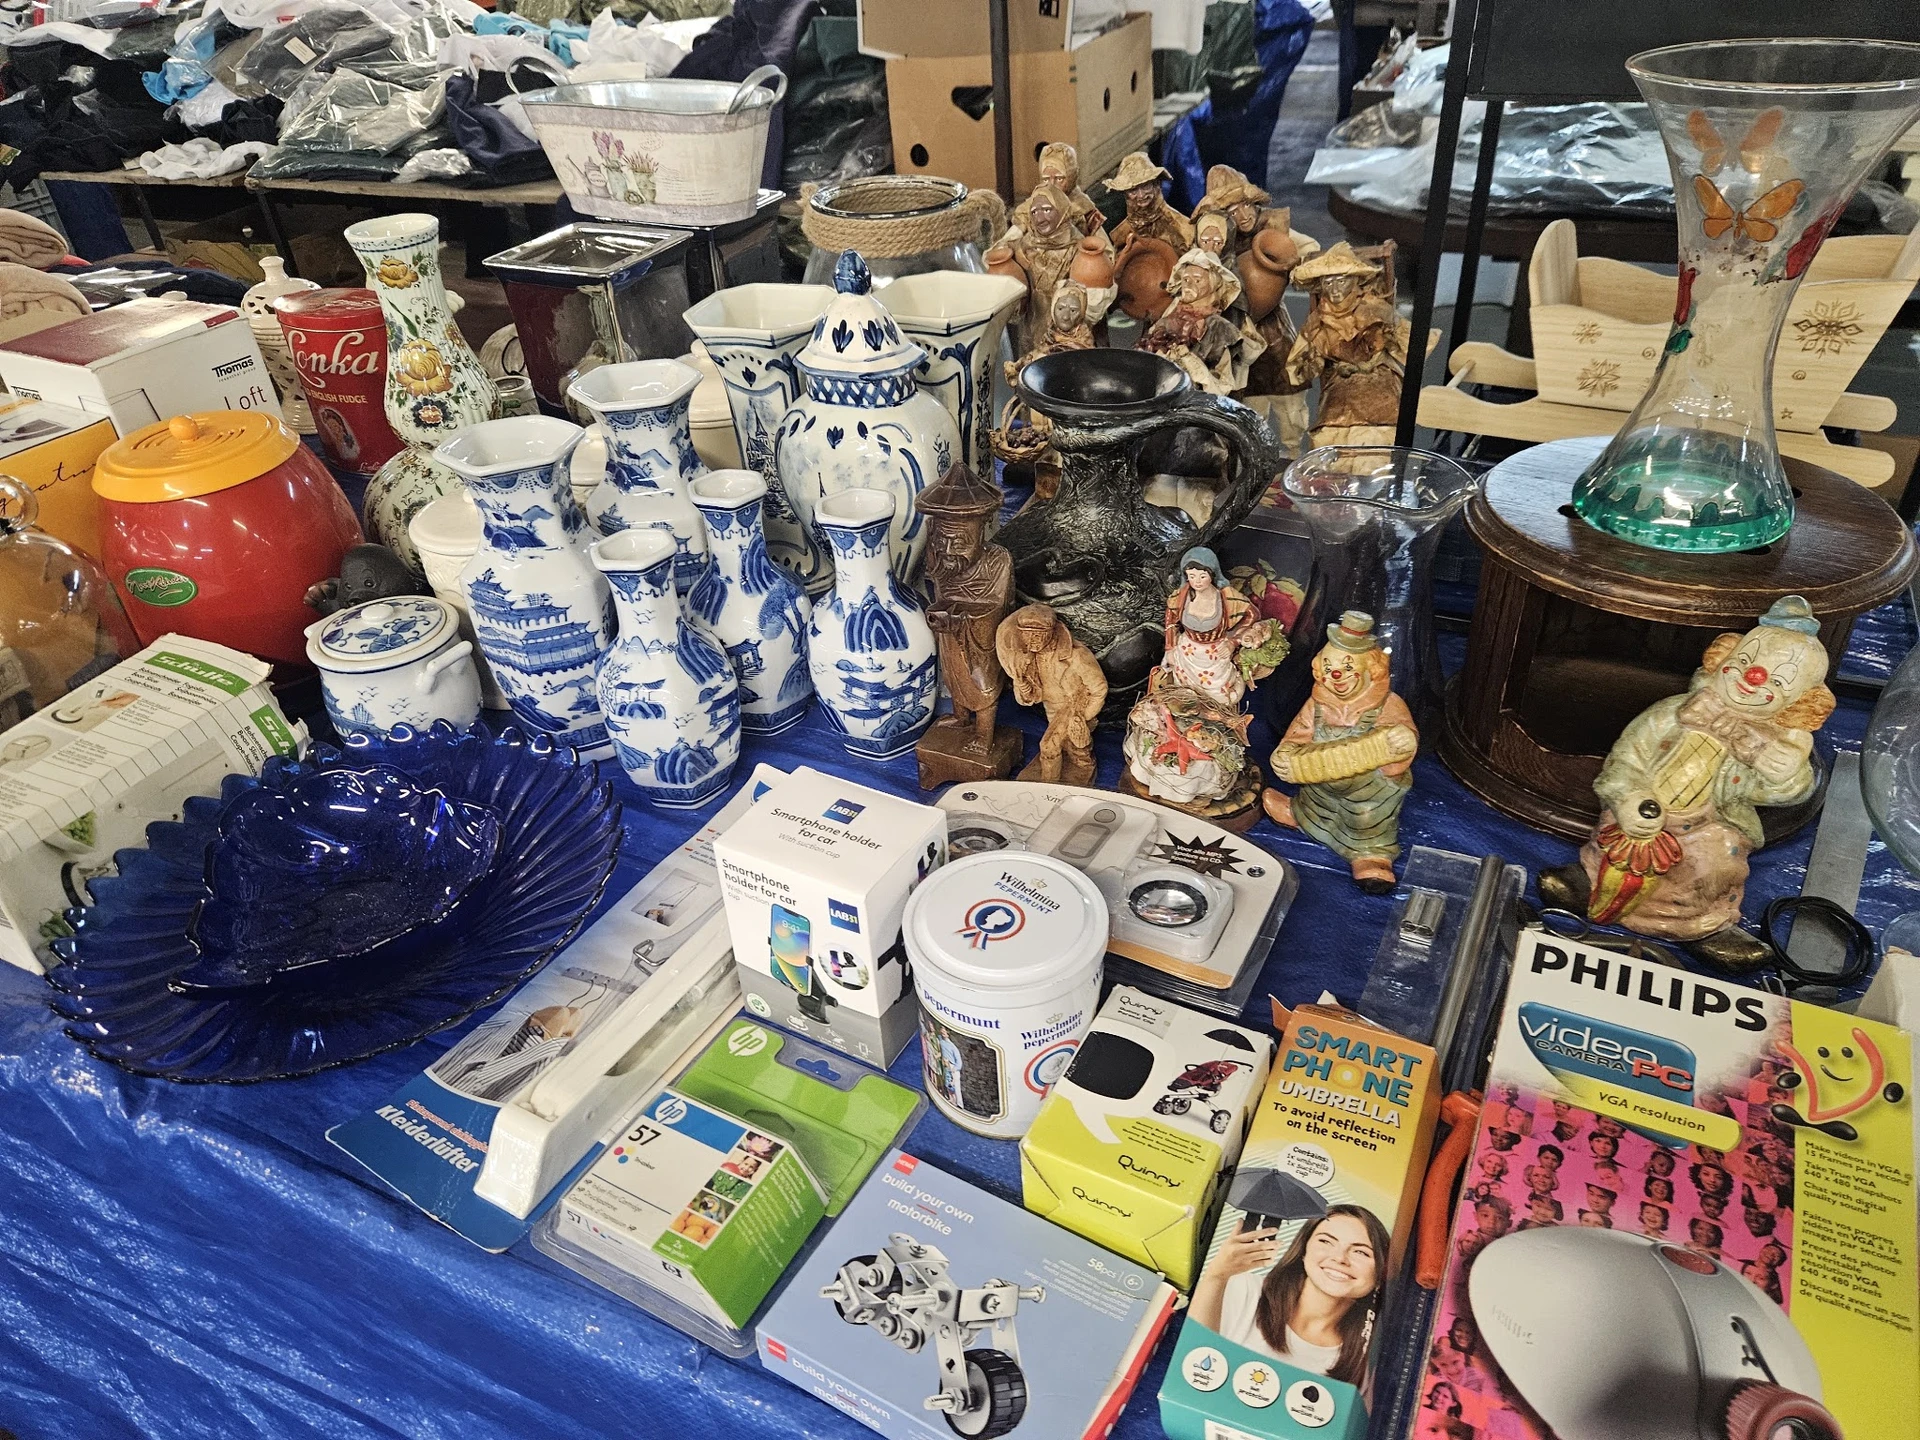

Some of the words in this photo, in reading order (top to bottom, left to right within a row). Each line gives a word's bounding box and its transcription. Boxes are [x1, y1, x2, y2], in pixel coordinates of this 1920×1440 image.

[212, 355, 254, 378] Thomas
[338, 394, 369, 404] FUDGE
[153, 655, 233, 687] Schulte
[237, 729, 251, 748] Bean
[249, 745, 261, 763] Slicer
[770, 808, 846, 836] Smartphone
[844, 830, 882, 850] holder
[778, 832, 795, 846] With
[797, 839, 825, 854] suction
[825, 847, 841, 860] cup
[798, 828, 817, 842] for
[818, 835, 838, 847] car
[722, 858, 790, 893] Smartphone
[724, 870, 758, 891] holder
[760, 885, 777, 899] for
[779, 895, 797, 907] car
[1000, 872, 1061, 911] Wilhelmina
[994, 881, 1052, 914] PEPERMUNT
[1530, 942, 1768, 1033] PHILIPS
[923, 989, 1001, 1030] pepermunt
[1120, 996, 1162, 1015] Quinny
[1020, 1010, 1082, 1040] Wilhelmina
[1023, 1018, 1081, 1050] pepermunt
[1295, 1026, 1422, 1078] SMART
[1520, 1015, 1658, 1066] video
[1631, 1059, 1694, 1092] PC
[1534, 1039, 1627, 1073] CAMERA
[1279, 1079, 1401, 1128] UMBRELLA
[1599, 1091, 1629, 1110] VGA
[1632, 1104, 1706, 1133] resolution
[375, 1104, 480, 1173] Kleiderlüfter
[628, 1124, 662, 1146] 57
[1273, 1101, 1288, 1112] To
[1291, 1106, 1325, 1123] avoid
[1328, 1116, 1396, 1145] reflection
[1286, 1118, 1302, 1129] on
[1306, 1121, 1328, 1137] the
[1331, 1130, 1377, 1151] screen
[1118, 1154, 1181, 1187] Quinny
[1293, 1146, 1329, 1163] Contains:
[1296, 1157, 1329, 1171] umbrella
[1296, 1164, 1324, 1177] suction
[1805, 1141, 1831, 1154] Make
[1833, 1151, 1864, 1164] videos
[1867, 1160, 1876, 1168] in
[1878, 1163, 1901, 1175] VGA
[1806, 1149, 1816, 1157] 15
[1819, 1153, 1853, 1168] frames
[1855, 1165, 1872, 1174] per
[1875, 1171, 1910, 1187] second
[1295, 1170, 1309, 1178] cup
[1804, 1169, 1821, 1179] 640
[1833, 1178, 1851, 1188] 480
[1853, 1184, 1902, 1205] snapshots
[1805, 1160, 1827, 1173] Take
[1852, 1175, 1877, 1188] VGA
[882, 1172, 915, 1195] build
[913, 1188, 946, 1210] your
[944, 1204, 975, 1224] own
[1072, 1186, 1132, 1217] Quinny
[1803, 1190, 1837, 1206] quality
[1840, 1200, 1869, 1215] sound
[1804, 1181, 1828, 1194] Chat
[1830, 1190, 1853, 1202] with
[1855, 1198, 1887, 1213] digital
[567, 1210, 581, 1224] 57
[887, 1198, 952, 1236] motorbike
[1802, 1210, 1832, 1225] Faites
[1835, 1221, 1852, 1231] vos
[1854, 1228, 1894, 1246] propres
[1802, 1219, 1834, 1234] vidéos
[1837, 1231, 1849, 1239] en
[1851, 1233, 1875, 1248] VGA
[1888, 1246, 1900, 1255] 15
[1802, 1227, 1837, 1243] images
[1840, 1240, 1857, 1250] par
[1860, 1247, 1903, 1265] seconde
[1801, 1249, 1814, 1258] en
[1816, 1254, 1862, 1274] véritable
[1801, 1257, 1853, 1279] résolution
[1854, 1274, 1880, 1289] VGA
[1802, 1240, 1837, 1257] Prenez
[1840, 1253, 1858, 1264] des
[1860, 1261, 1896, 1277] photos
[1800, 1279, 1845, 1301] Discutez
[1848, 1296, 1871, 1310] avec
[1874, 1306, 1888, 1315] un
[1801, 1266, 1819, 1277] 640
[1831, 1276, 1849, 1287] 480
[1852, 1284, 1883, 1299] pixels
[1799, 1288, 1812, 1297] de
[1815, 1294, 1851, 1311] qualité
[1854, 1307, 1913, 1333] numérique
[792, 1358, 825, 1382] build
[826, 1377, 859, 1401] your
[859, 1398, 891, 1420] own
[813, 1385, 881, 1429] motorbike
